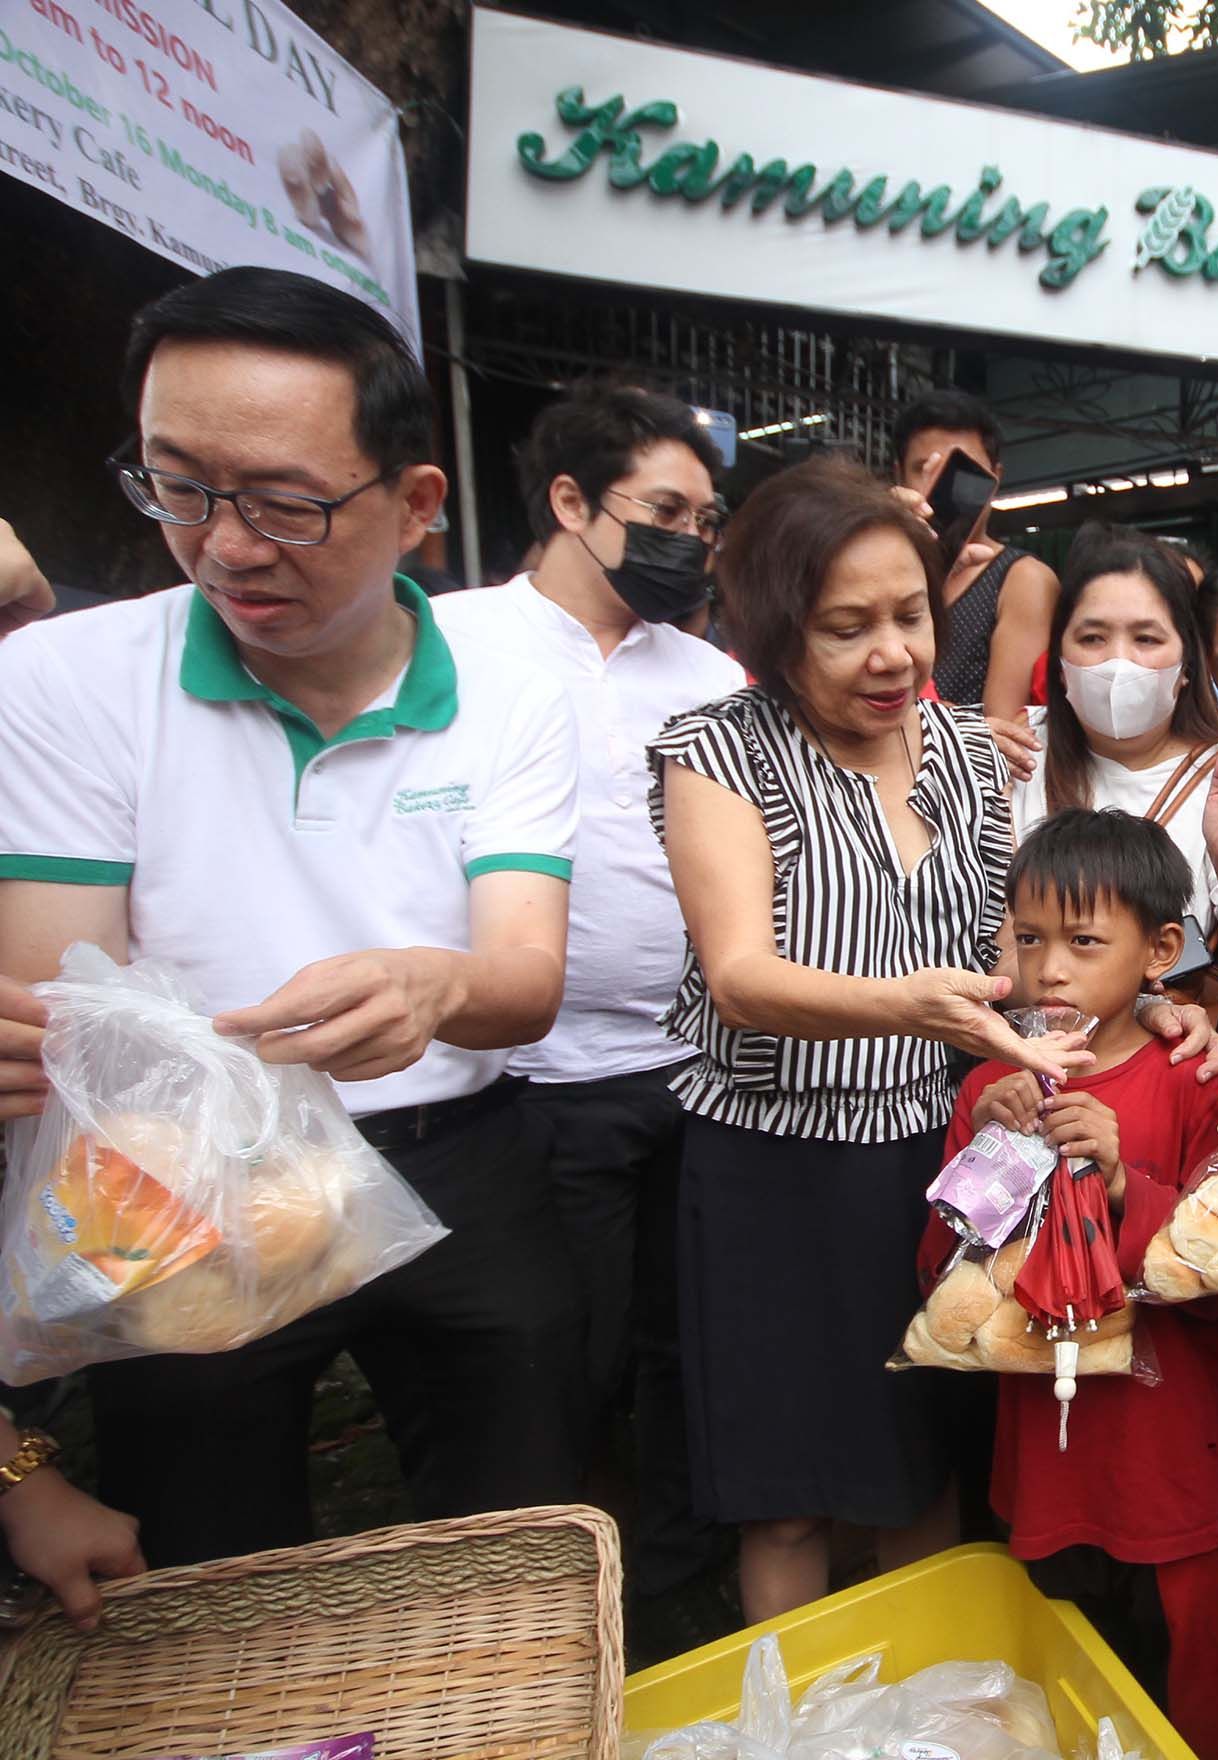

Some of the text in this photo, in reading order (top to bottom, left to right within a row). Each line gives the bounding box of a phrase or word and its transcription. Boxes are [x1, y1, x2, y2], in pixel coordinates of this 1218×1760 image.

[90, 26, 126, 74] to
[135, 58, 174, 110] 12
[181, 97, 255, 165] noon
[97, 0, 218, 91] ISSION
[244, 0, 340, 117] DAY
[74, 125, 141, 191] Cafe
[119, 112, 152, 157] 16
[157, 137, 257, 229] Monday
[516, 85, 1110, 290] Kamuning
